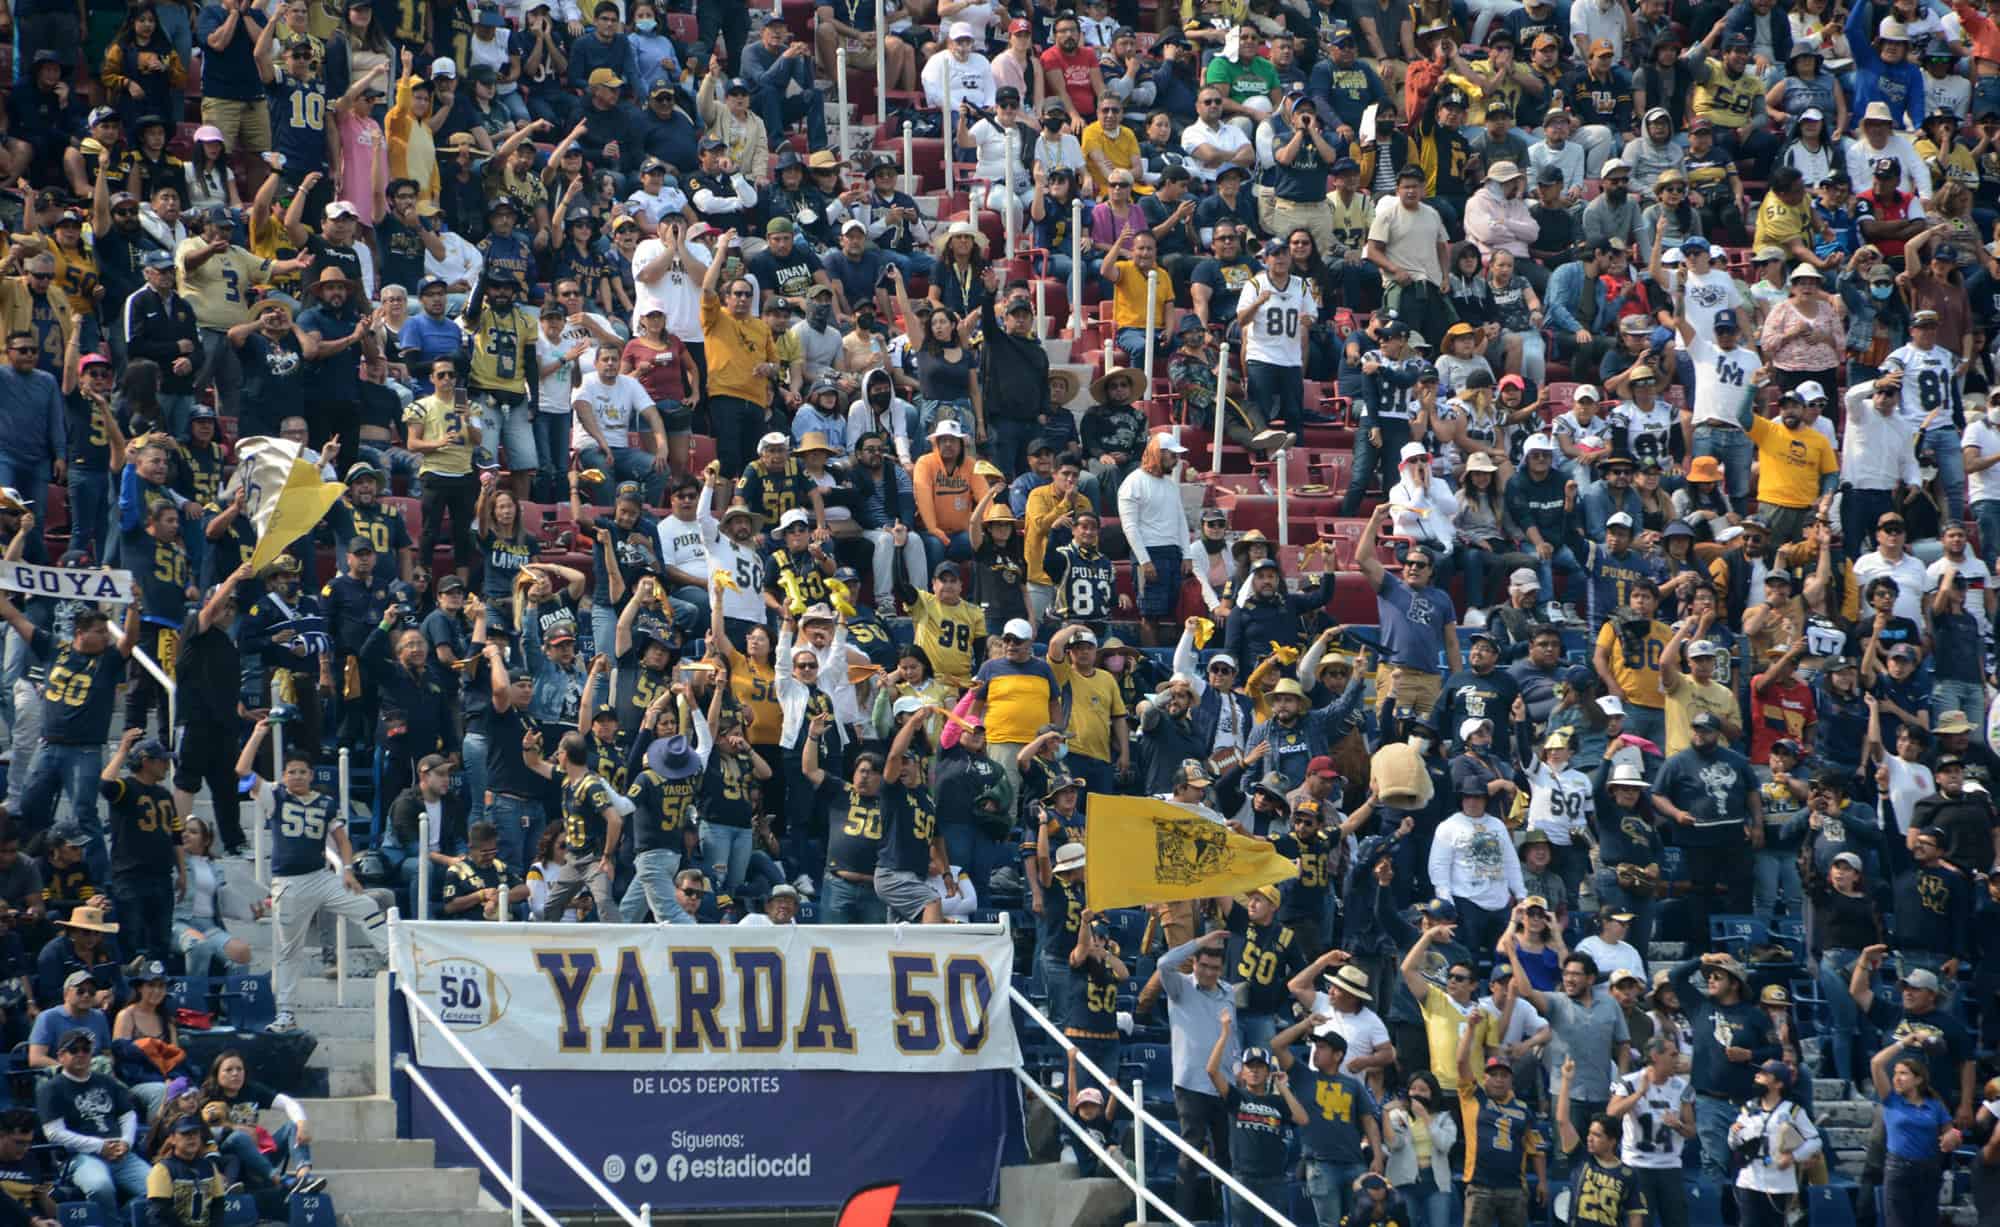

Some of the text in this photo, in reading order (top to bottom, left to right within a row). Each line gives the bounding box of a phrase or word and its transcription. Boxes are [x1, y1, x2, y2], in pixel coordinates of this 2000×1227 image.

[290, 90, 325, 130] 10
[65, 267, 97, 296] 50
[222, 270, 241, 303] 3
[776, 263, 811, 282] UNAM
[1267, 308, 1297, 339] 80
[1918, 369, 1951, 412] 81
[443, 413, 464, 445] 2
[763, 492, 796, 524] 50
[353, 521, 388, 553] 50
[15, 566, 123, 598] GOYA
[154, 547, 188, 587] 50
[736, 557, 764, 595] 50
[1601, 564, 1642, 582] PUMAS
[1070, 579, 1113, 617] 83
[938, 620, 972, 652] 38
[46, 665, 94, 709] 50
[137, 797, 175, 834] 30
[1552, 787, 1584, 820] 50
[281, 801, 327, 841] 55
[842, 806, 883, 841] 50
[914, 808, 935, 842] 50
[1301, 857, 1330, 887] 50
[1238, 943, 1277, 985] 50
[241, 980, 257, 992] 20
[441, 976, 482, 1008] 50
[532, 946, 995, 1056] YARDA 50
[1086, 983, 1118, 1014] 50
[633, 1077, 780, 1094] DE LOS DEPORTES
[672, 1131, 744, 1152] Síguenos:
[690, 1153, 811, 1178] estadiocdd
